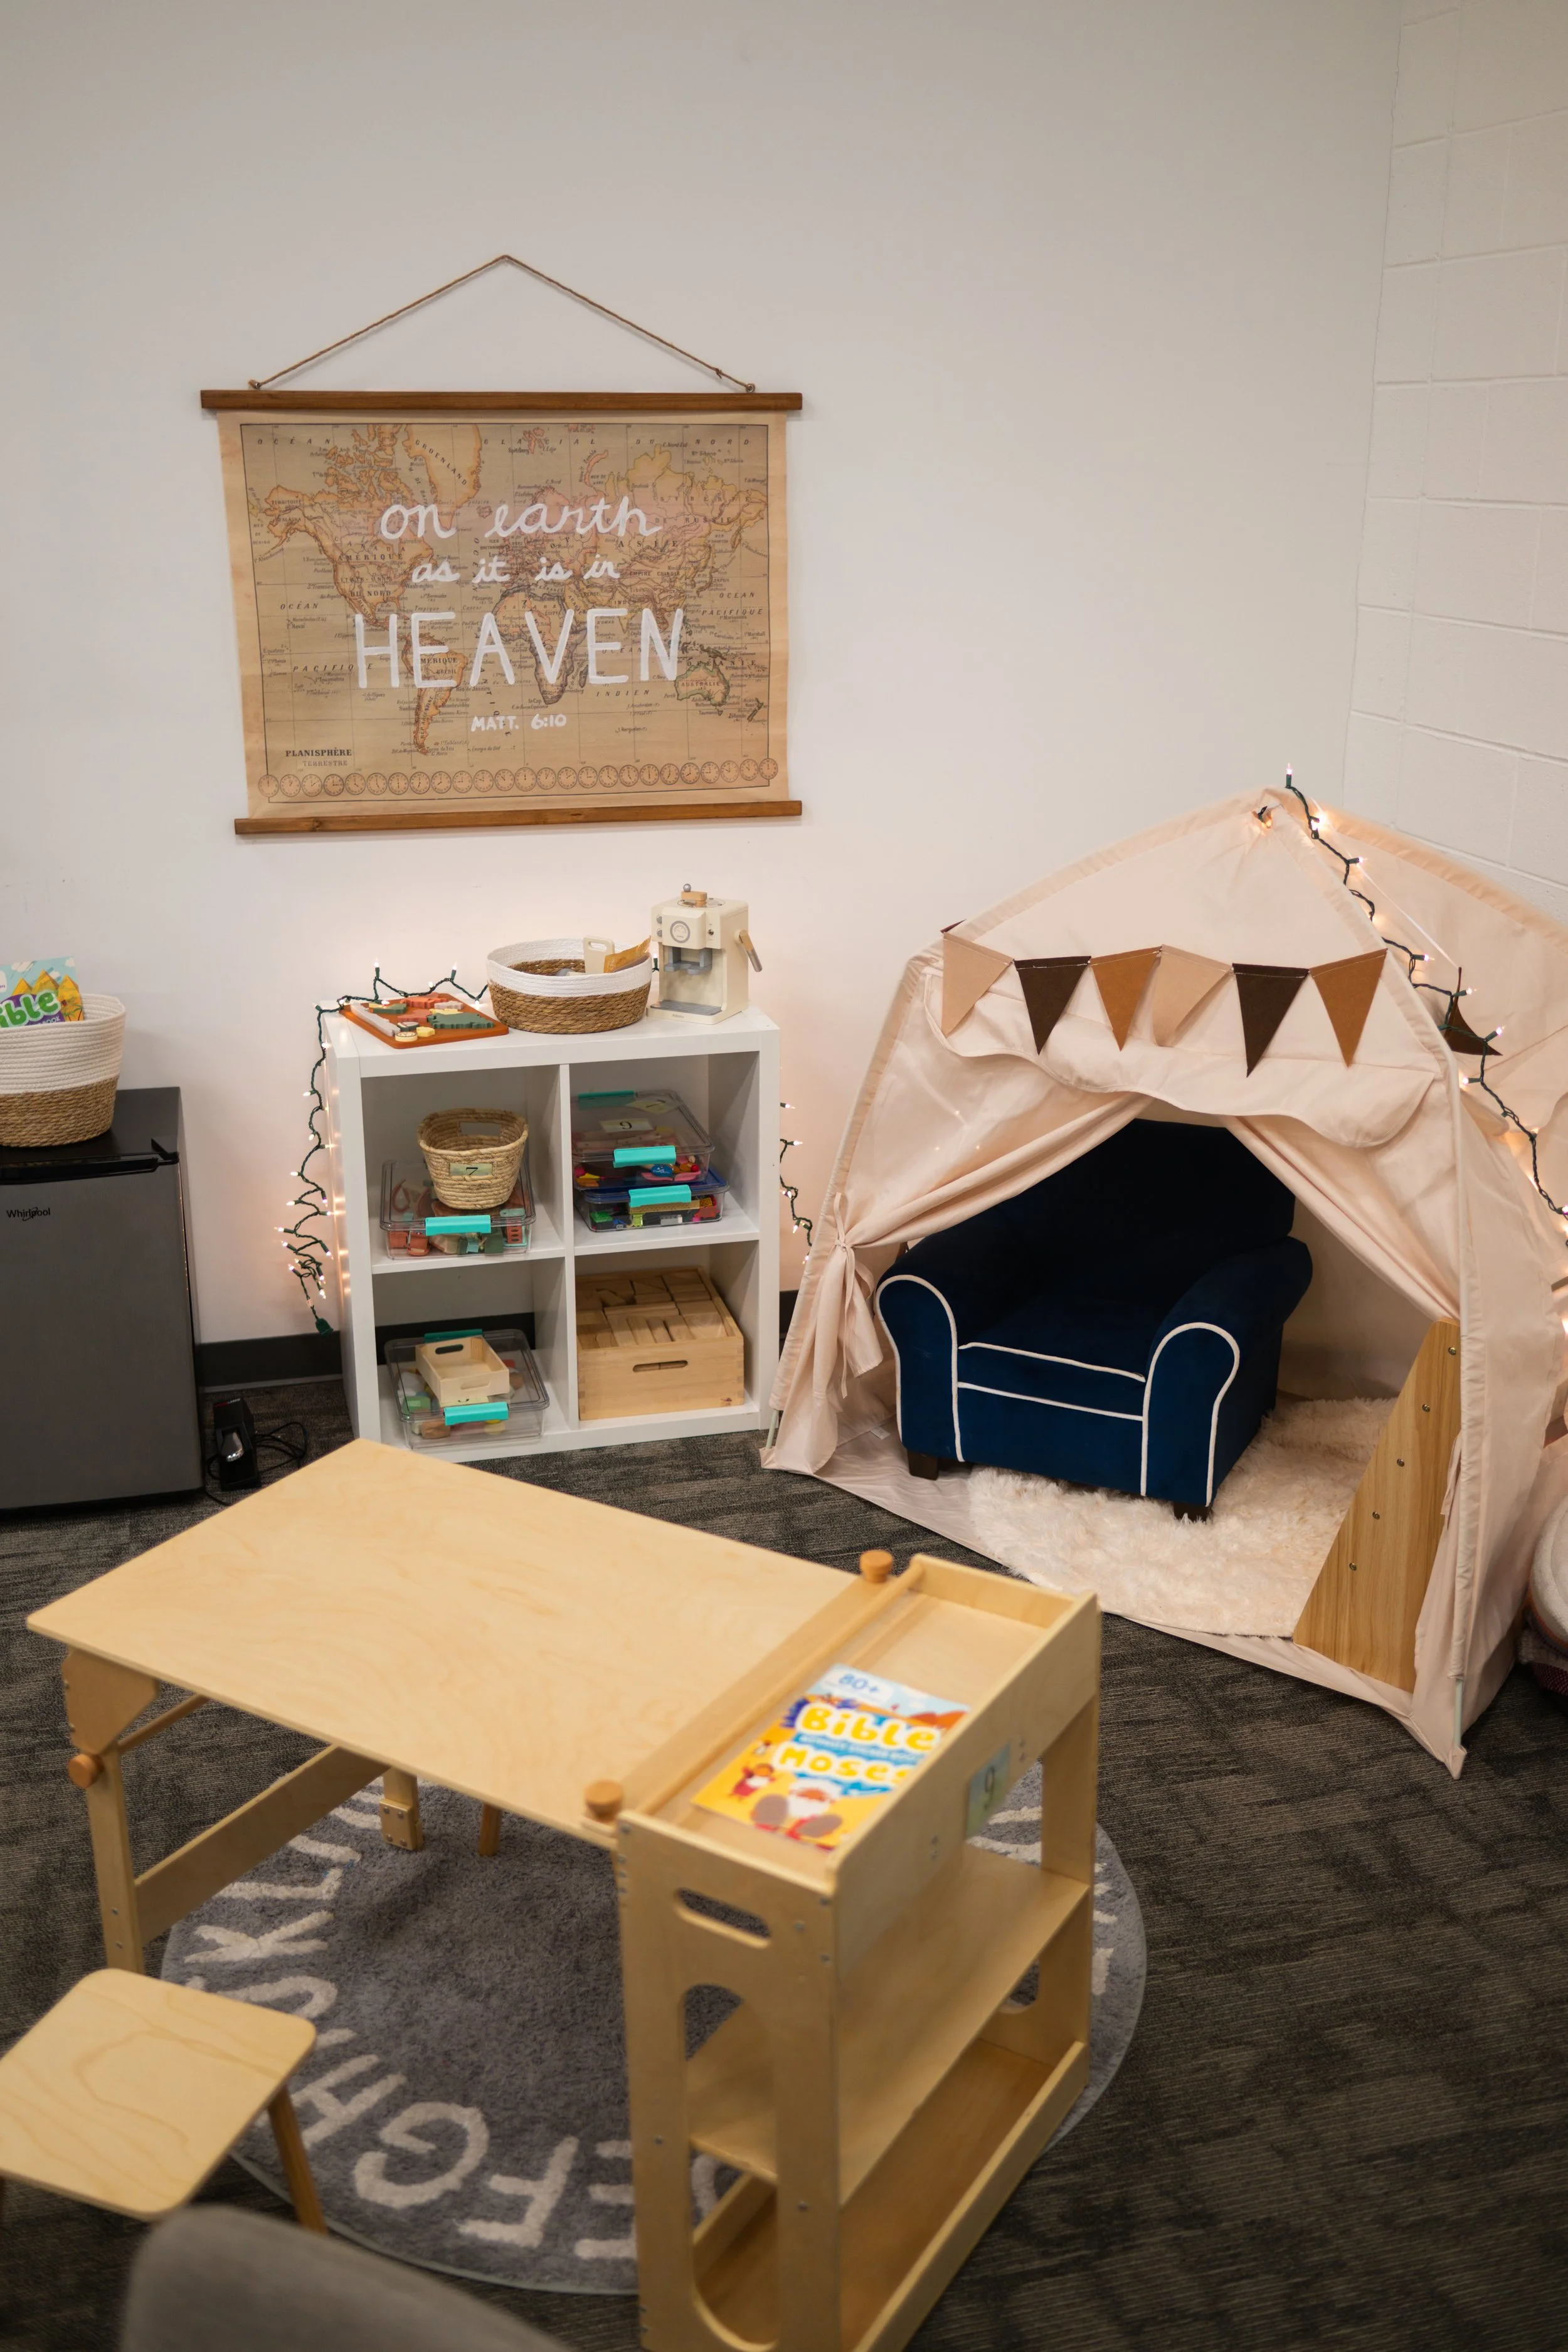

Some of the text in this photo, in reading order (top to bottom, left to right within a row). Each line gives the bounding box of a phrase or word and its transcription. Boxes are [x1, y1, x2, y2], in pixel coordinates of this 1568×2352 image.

[415, 440, 467, 486] GROENLAND
[381, 496, 662, 540] on earth
[411, 554, 620, 584] as it is in
[280, 600, 319, 610] OCÉAN
[701, 608, 763, 616] PACIFIQUE
[355, 608, 684, 689] HEAVEN
[293, 663, 373, 672] PACIFIQE
[471, 713, 567, 733] MATT. 6:10
[285, 747, 352, 757] PLANISPHÈRE
[6, 1207, 51, 1221] Whirlpool
[800, 1705, 936, 1752] Bible
